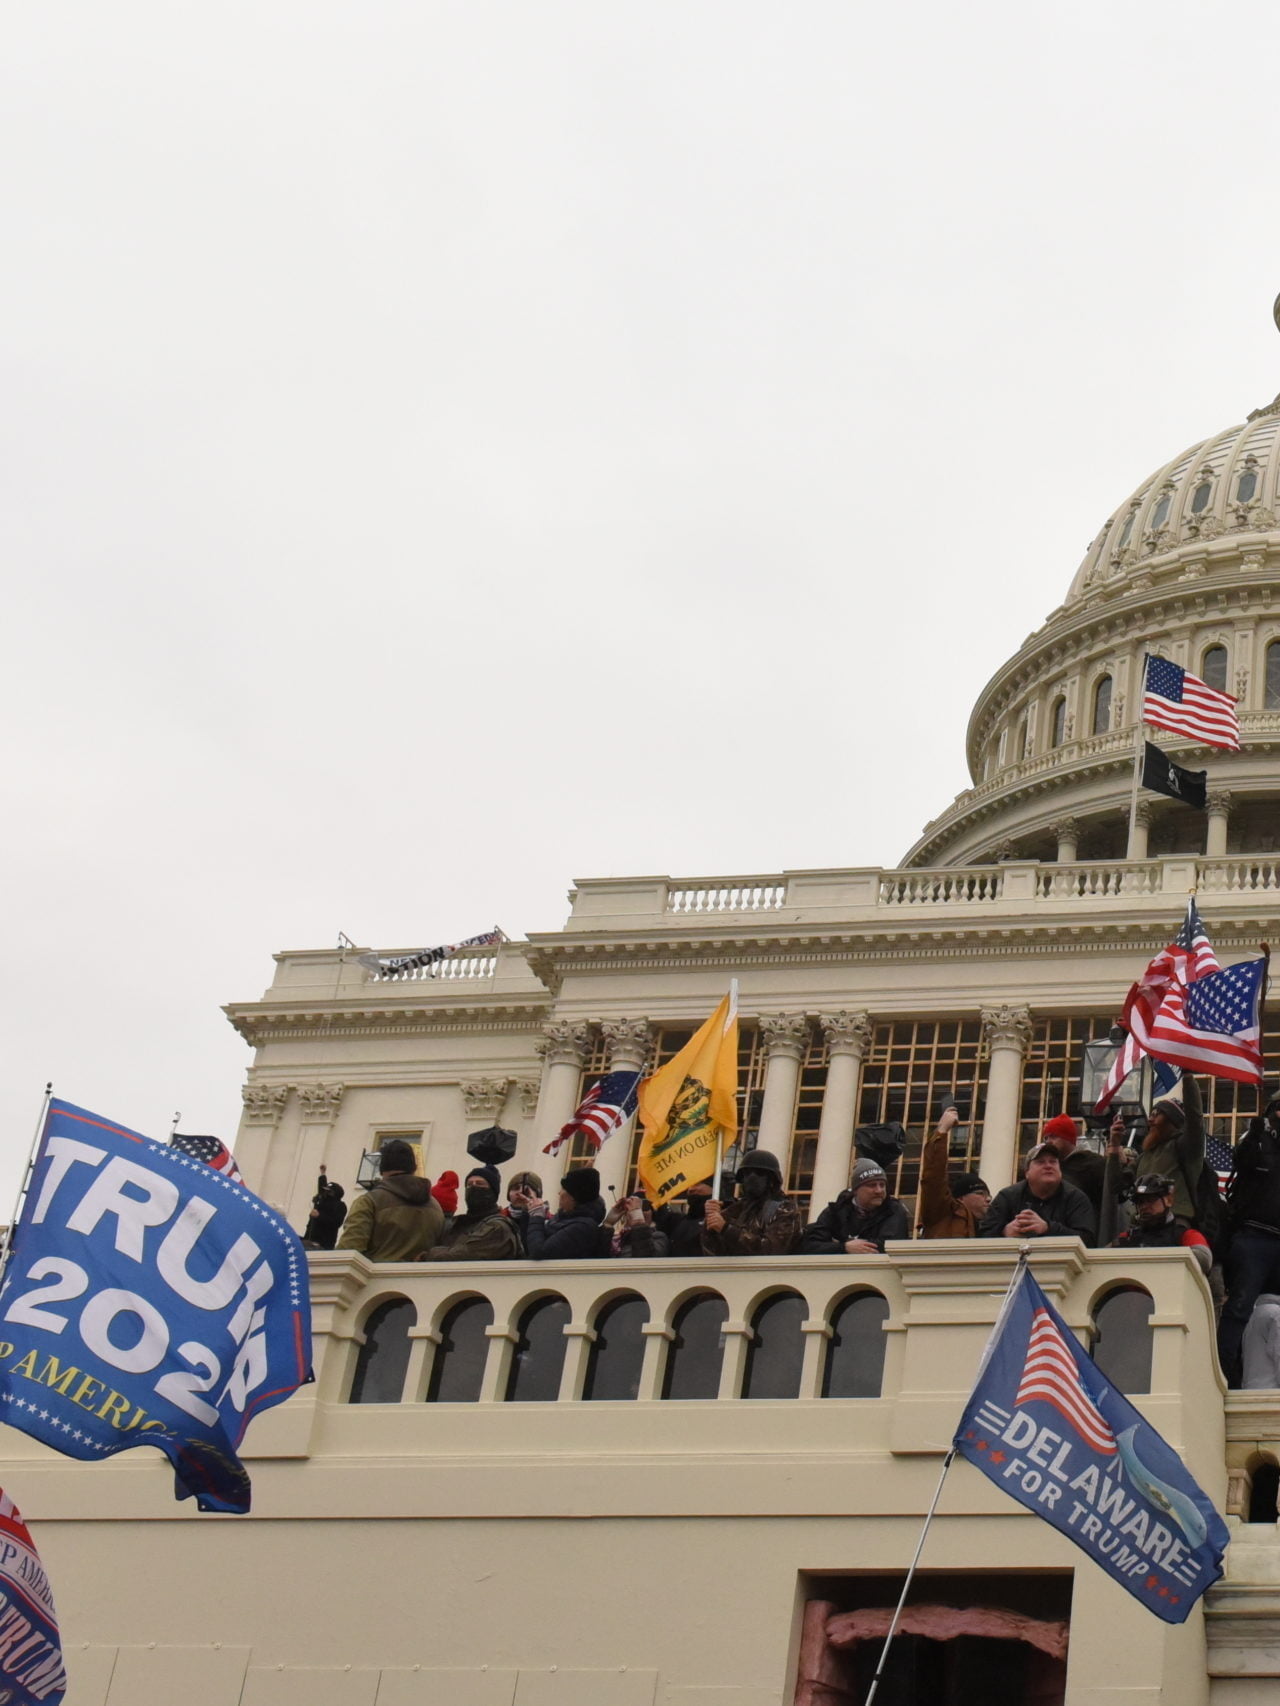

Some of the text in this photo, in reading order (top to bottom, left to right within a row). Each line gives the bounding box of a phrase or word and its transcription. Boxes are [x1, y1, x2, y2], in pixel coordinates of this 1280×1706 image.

[4, 1256, 222, 1428] 202
[8, 1349, 178, 1435] AMERI
[1002, 1410, 1191, 1574] DELAWARE
[1003, 1458, 1149, 1578] FOR TRUMP
